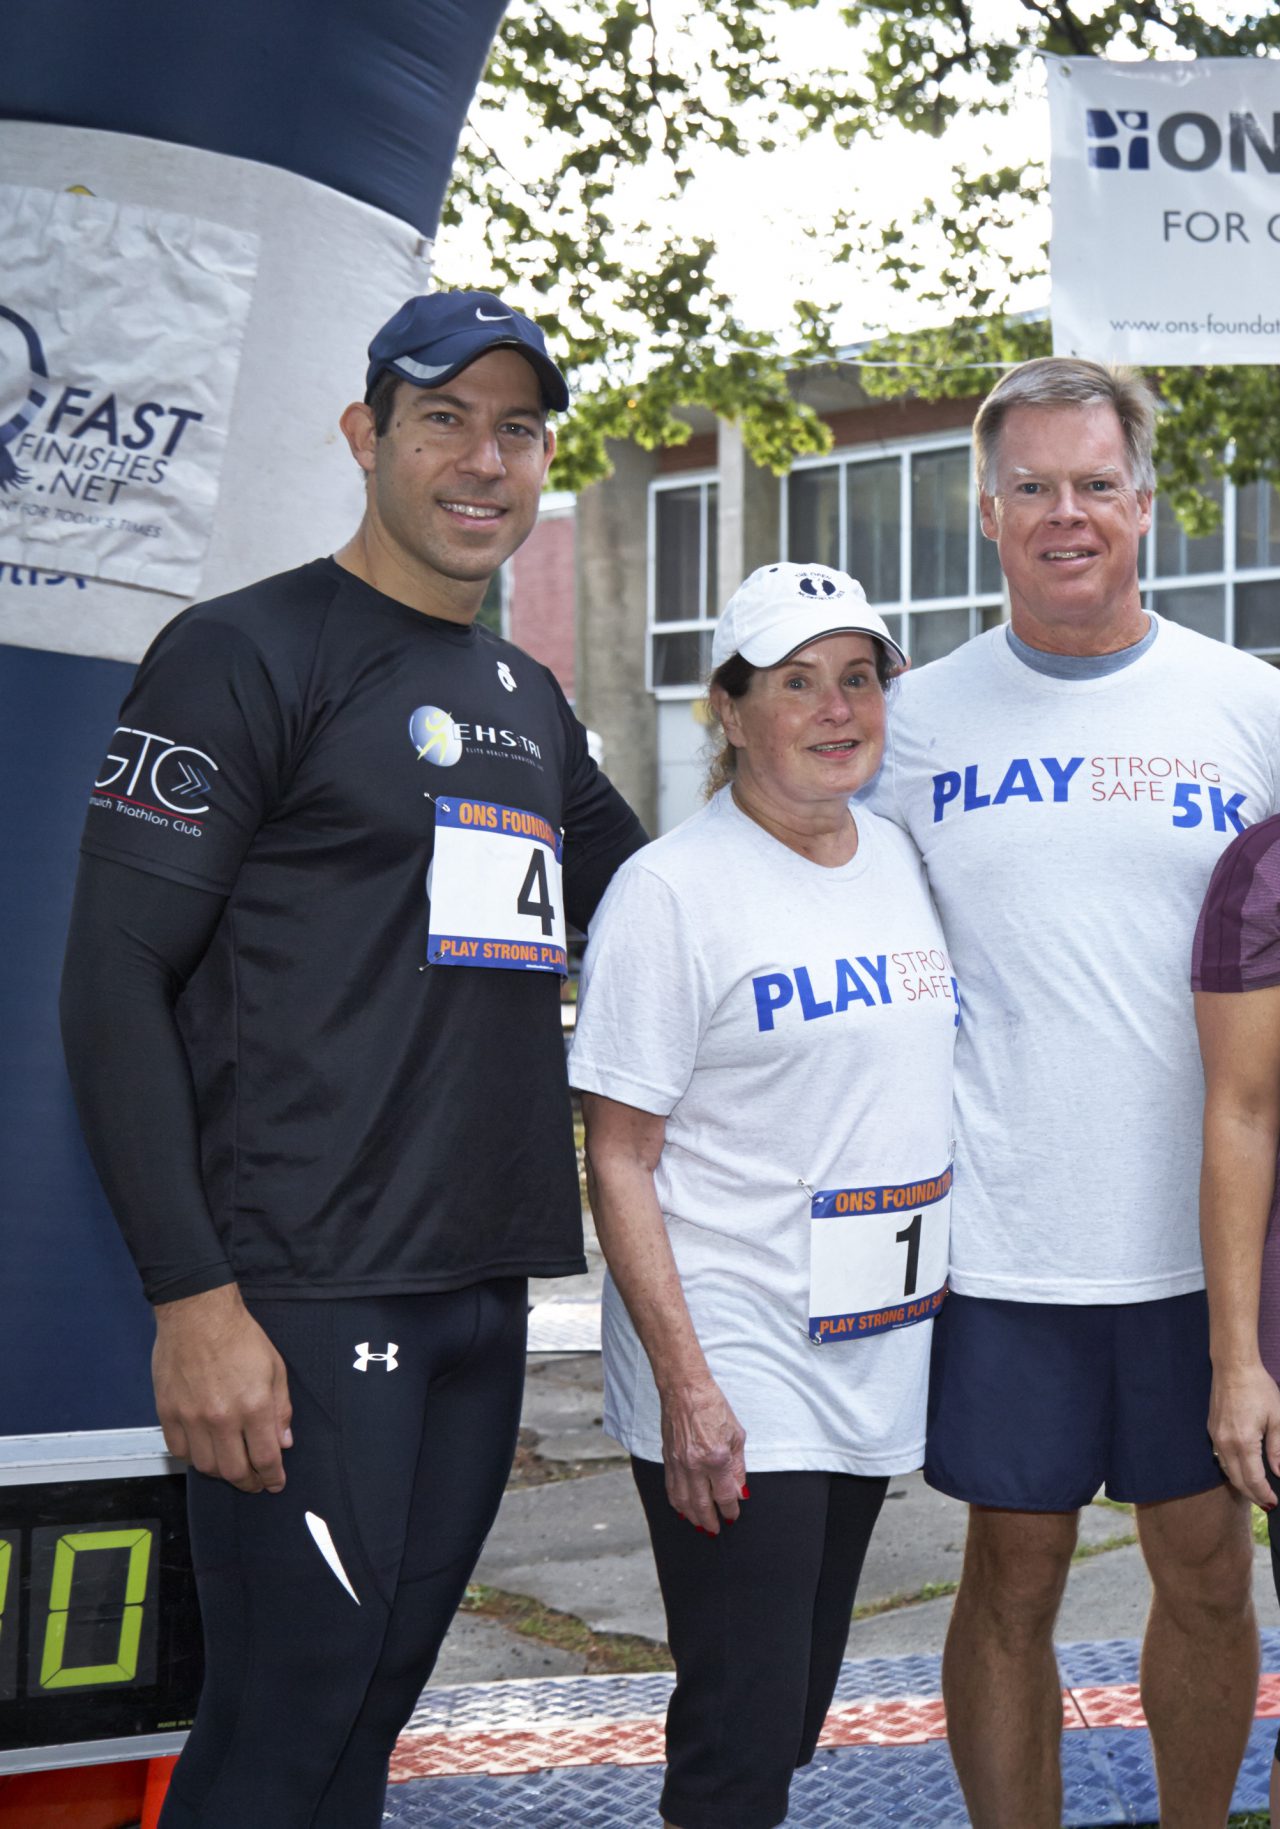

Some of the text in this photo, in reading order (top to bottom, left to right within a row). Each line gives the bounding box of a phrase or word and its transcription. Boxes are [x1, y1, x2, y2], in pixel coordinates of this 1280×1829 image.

[1163, 210, 1251, 243] FOR
[46, 386, 203, 457] FAST
[15, 433, 169, 485] FINISHES
[36, 471, 129, 506] .NET
[1091, 757, 1221, 783] STRONG
[932, 757, 1085, 823] PLAY
[1091, 781, 1165, 802] SAFE
[116, 800, 168, 828] Triathlon
[173, 820, 202, 837] Club
[459, 802, 498, 828] ONS
[1172, 783, 1247, 836] 5K
[517, 848, 555, 937] 4
[440, 940, 479, 957] PLAY
[483, 942, 538, 961] STRONG
[752, 954, 893, 1033] PLAY
[903, 976, 951, 1001] SAFE
[835, 1191, 876, 1213] ONS
[895, 1214, 922, 1297] 1
[820, 1317, 855, 1334] PLAY
[858, 1308, 904, 1330] STRONG
[908, 1299, 931, 1319] PLAY
